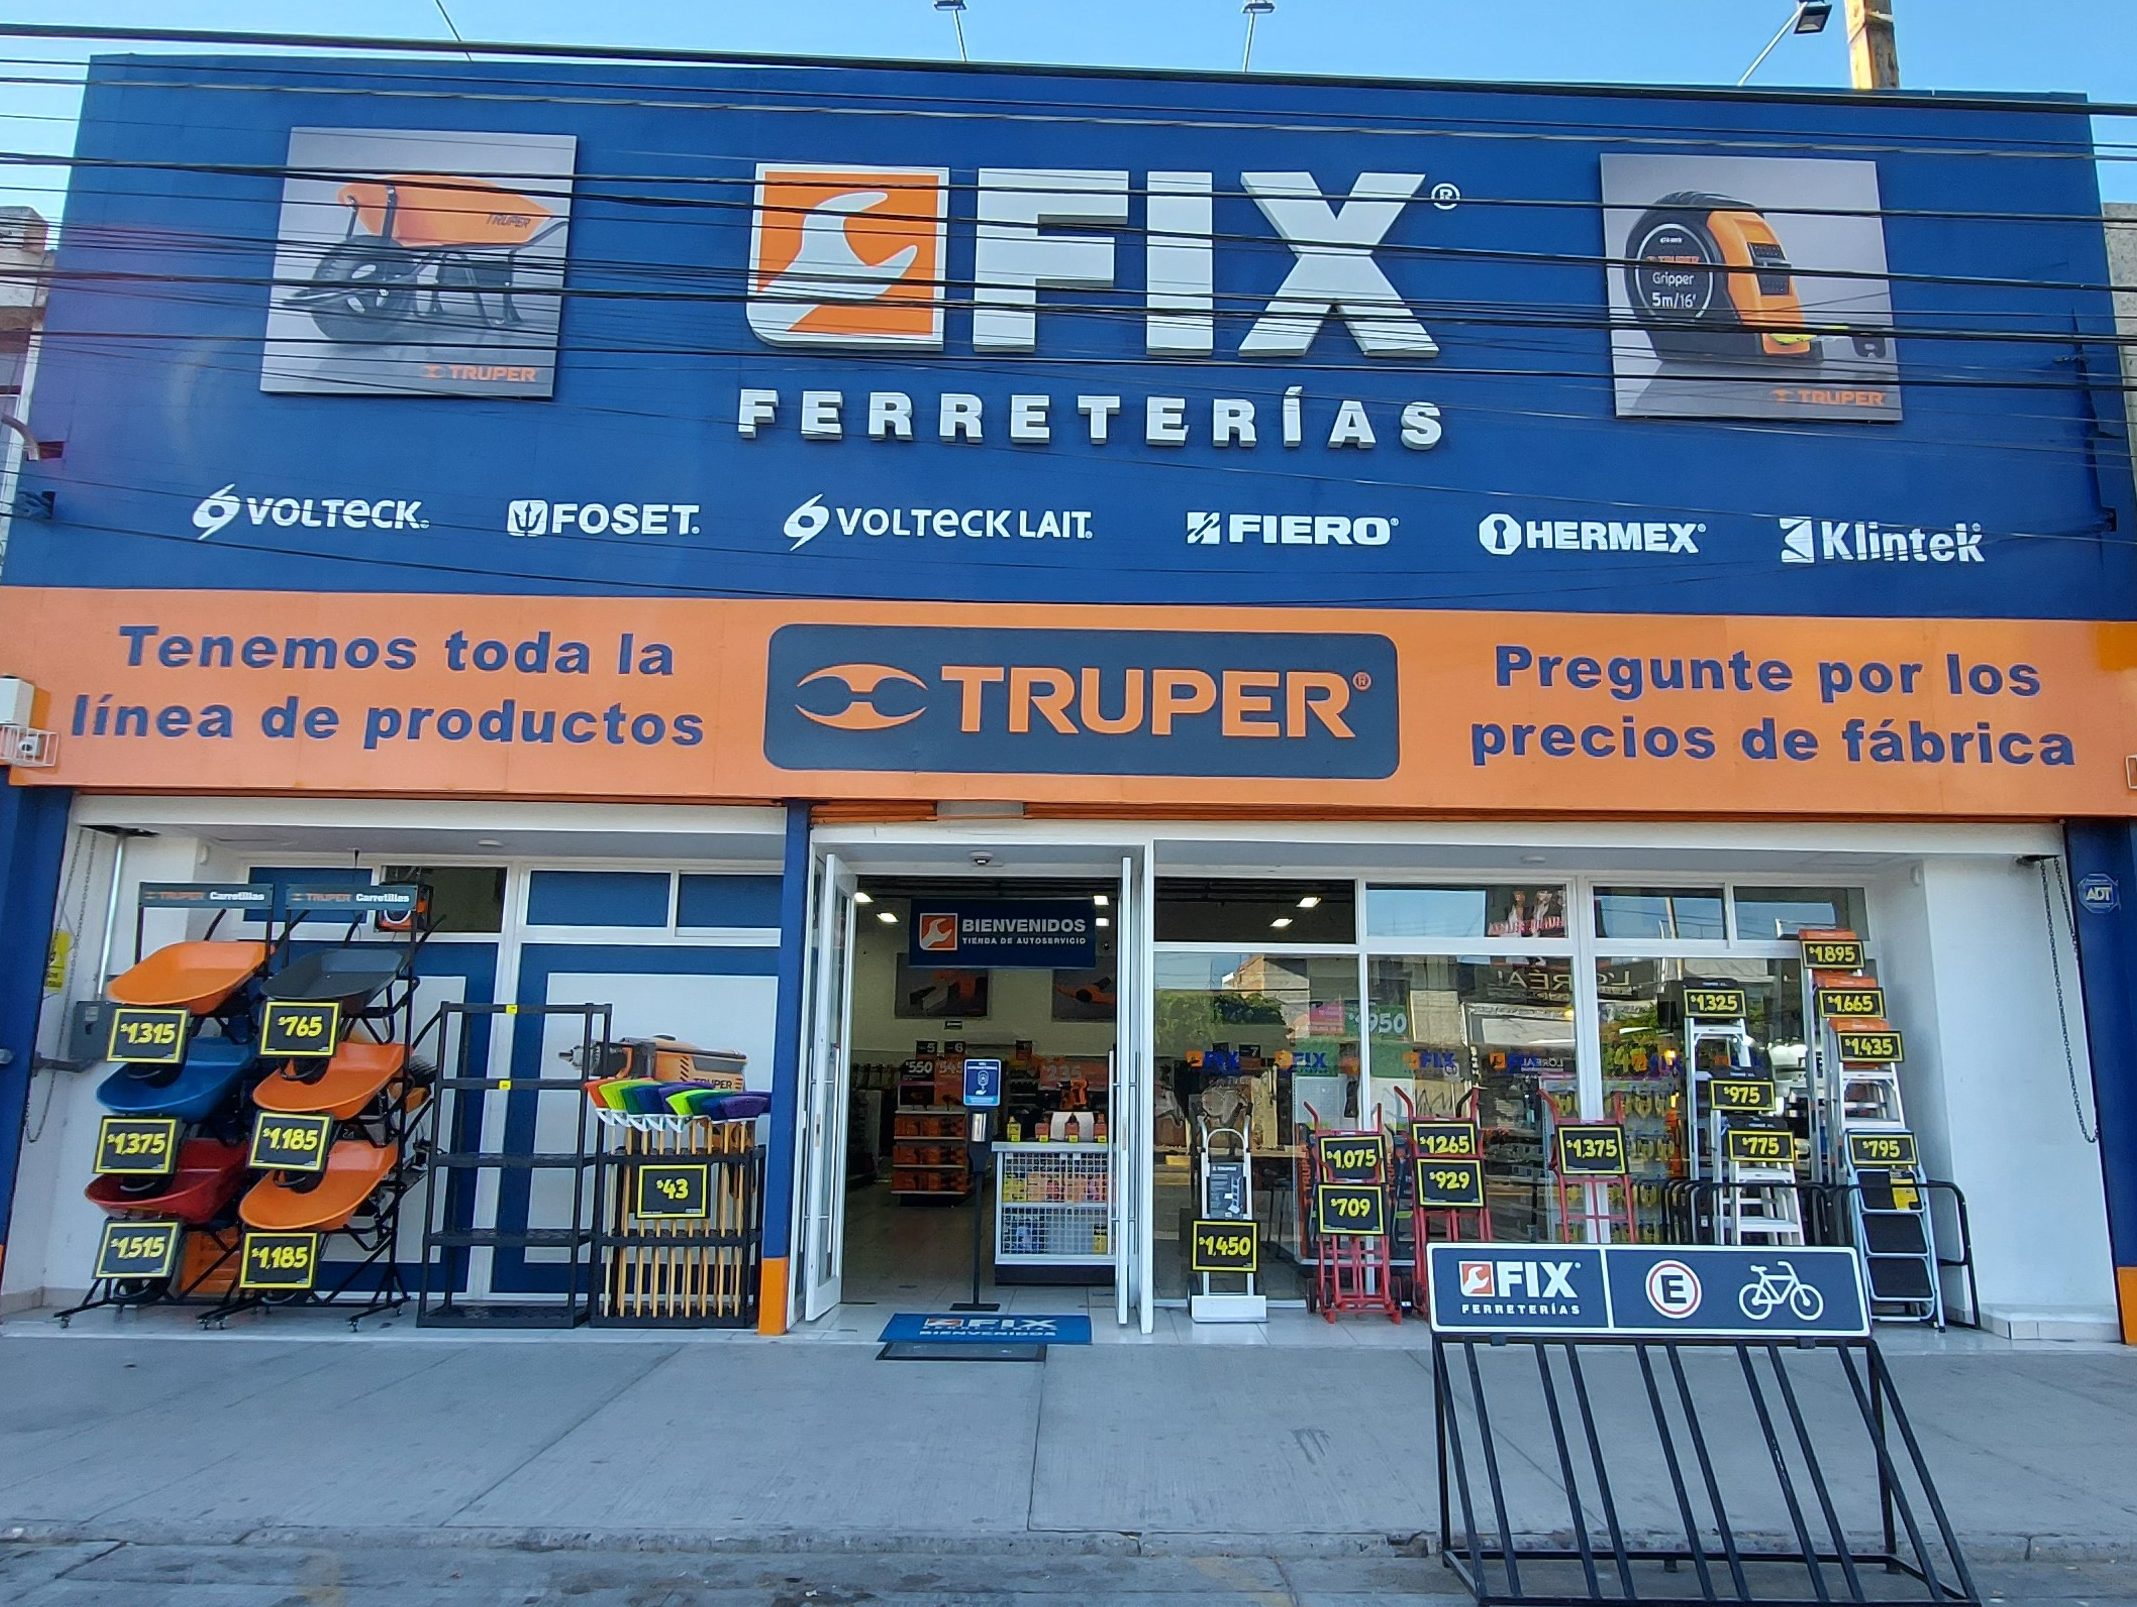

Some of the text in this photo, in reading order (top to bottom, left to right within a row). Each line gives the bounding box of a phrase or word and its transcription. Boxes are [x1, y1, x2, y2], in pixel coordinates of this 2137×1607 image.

[486, 213, 531, 229] TRUPER
[973, 167, 1440, 357] FIX
[1652, 271, 1695, 287] Gripper
[448, 365, 536, 383] TRUPER
[1796, 388, 1886, 407] TRUPER
[738, 386, 1443, 450] FERRETERÍAS
[551, 501, 694, 536] FOSET
[1019, 510, 1087, 539] LAIT
[1228, 514, 1392, 546] FIERO
[1526, 520, 1700, 554] HERMEX
[1821, 520, 1985, 562] Klintek
[120, 626, 674, 676] Tenemos toda la
[1496, 645, 2041, 703] Pregunte por los
[941, 665, 1356, 739] TRUPER
[72, 694, 704, 750] línea de productos
[1471, 715, 2076, 766] precios de fábrica
[209, 892, 264, 902] Carretillas
[356, 893, 410, 903] Carretillas
[2086, 887, 2112, 901] ADT
[962, 918, 1086, 933] BIENVENIDOS
[1016, 937, 1086, 945] AUTOSERVICIO
[120, 1021, 176, 1045] $1,315
[278, 1015, 323, 1037] $765
[906, 1060, 933, 1074] $550
[1723, 1086, 1761, 1104] $975
[107, 1132, 166, 1155] $1,375
[263, 1127, 318, 1151] $1,185
[1566, 1138, 1618, 1160] $1,375
[1742, 1136, 1780, 1155] $775
[1862, 1139, 1900, 1158] $795
[1326, 1148, 1377, 1169] $1,075
[656, 1177, 689, 1201] $43
[1429, 1171, 1470, 1190] $929
[1330, 1198, 1371, 1217] $709
[110, 1235, 165, 1259] $1,515
[1199, 1235, 1251, 1257] $1,450
[251, 1246, 308, 1270] $1,185
[1496, 1260, 1578, 1299] FIX
[1660, 1274, 1687, 1304] E
[1461, 1302, 1581, 1315] FERRETERÍAS
[968, 1319, 1057, 1329] FIX
